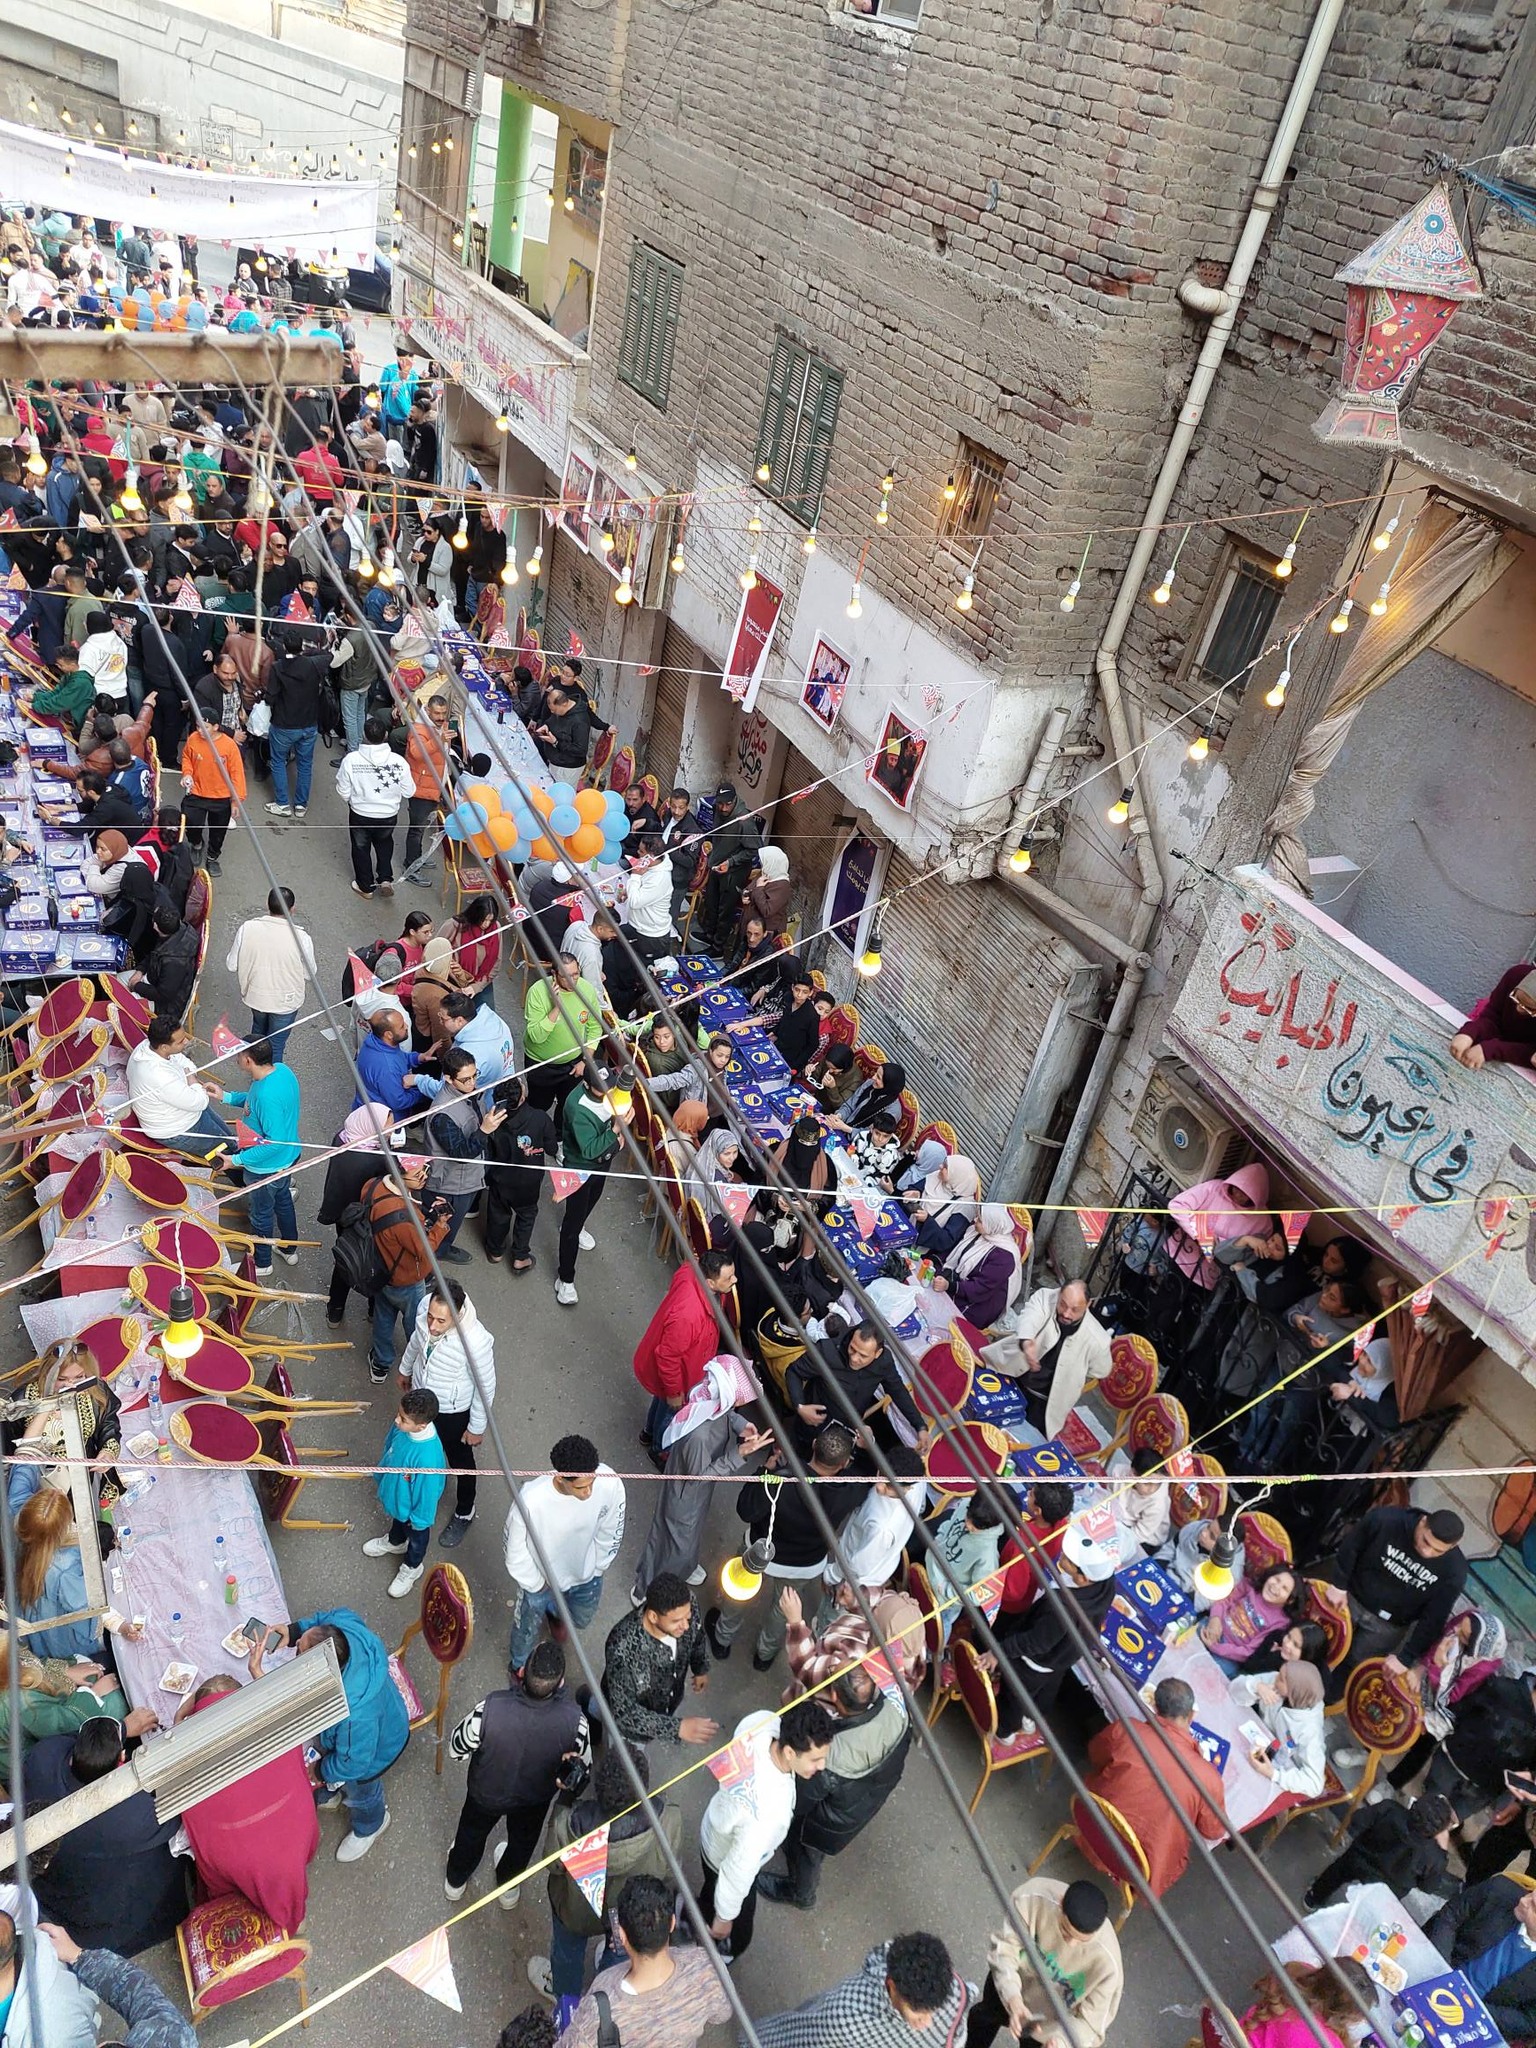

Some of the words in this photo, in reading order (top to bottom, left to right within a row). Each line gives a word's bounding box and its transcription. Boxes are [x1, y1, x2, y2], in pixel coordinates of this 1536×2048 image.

[1325, 1032, 1436, 1155] عيون
[1408, 1124, 1476, 1207] في
[1386, 1543, 1439, 1585] WARRIOR
